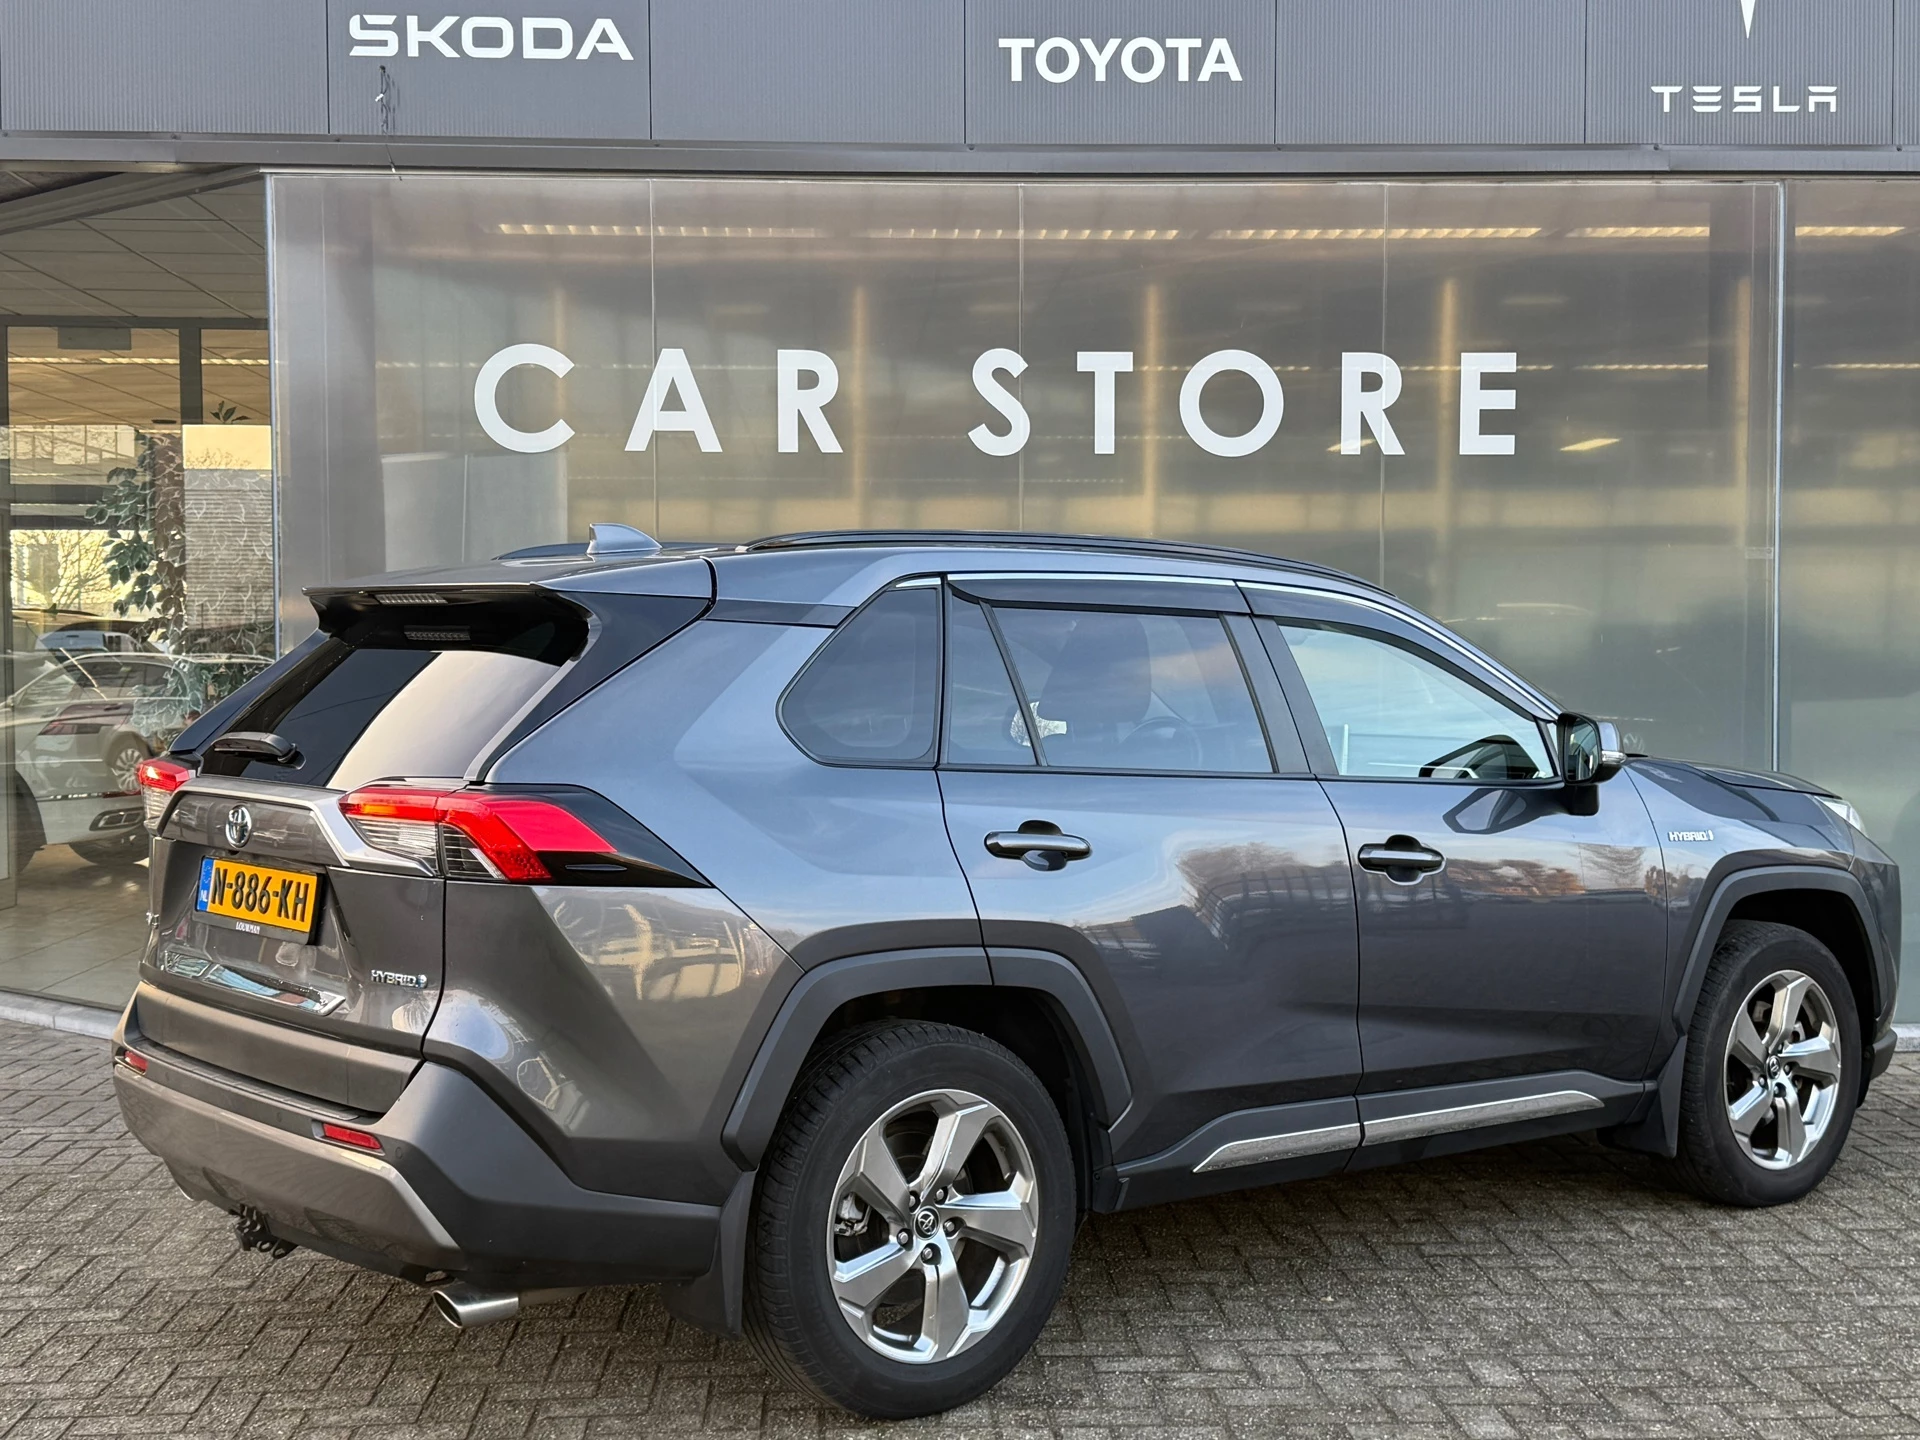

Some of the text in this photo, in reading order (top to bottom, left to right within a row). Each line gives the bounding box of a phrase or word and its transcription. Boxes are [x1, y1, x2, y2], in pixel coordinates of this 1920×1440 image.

[998, 36, 1243, 84] TOYOTA
[1650, 85, 1838, 113] TESLA
[474, 343, 1518, 457] CAR STORE
[1668, 830, 1708, 842] HYBRID
[199, 888, 209, 902] NL
[210, 867, 310, 923] N-886-KH
[371, 969, 417, 987] HYBRID
